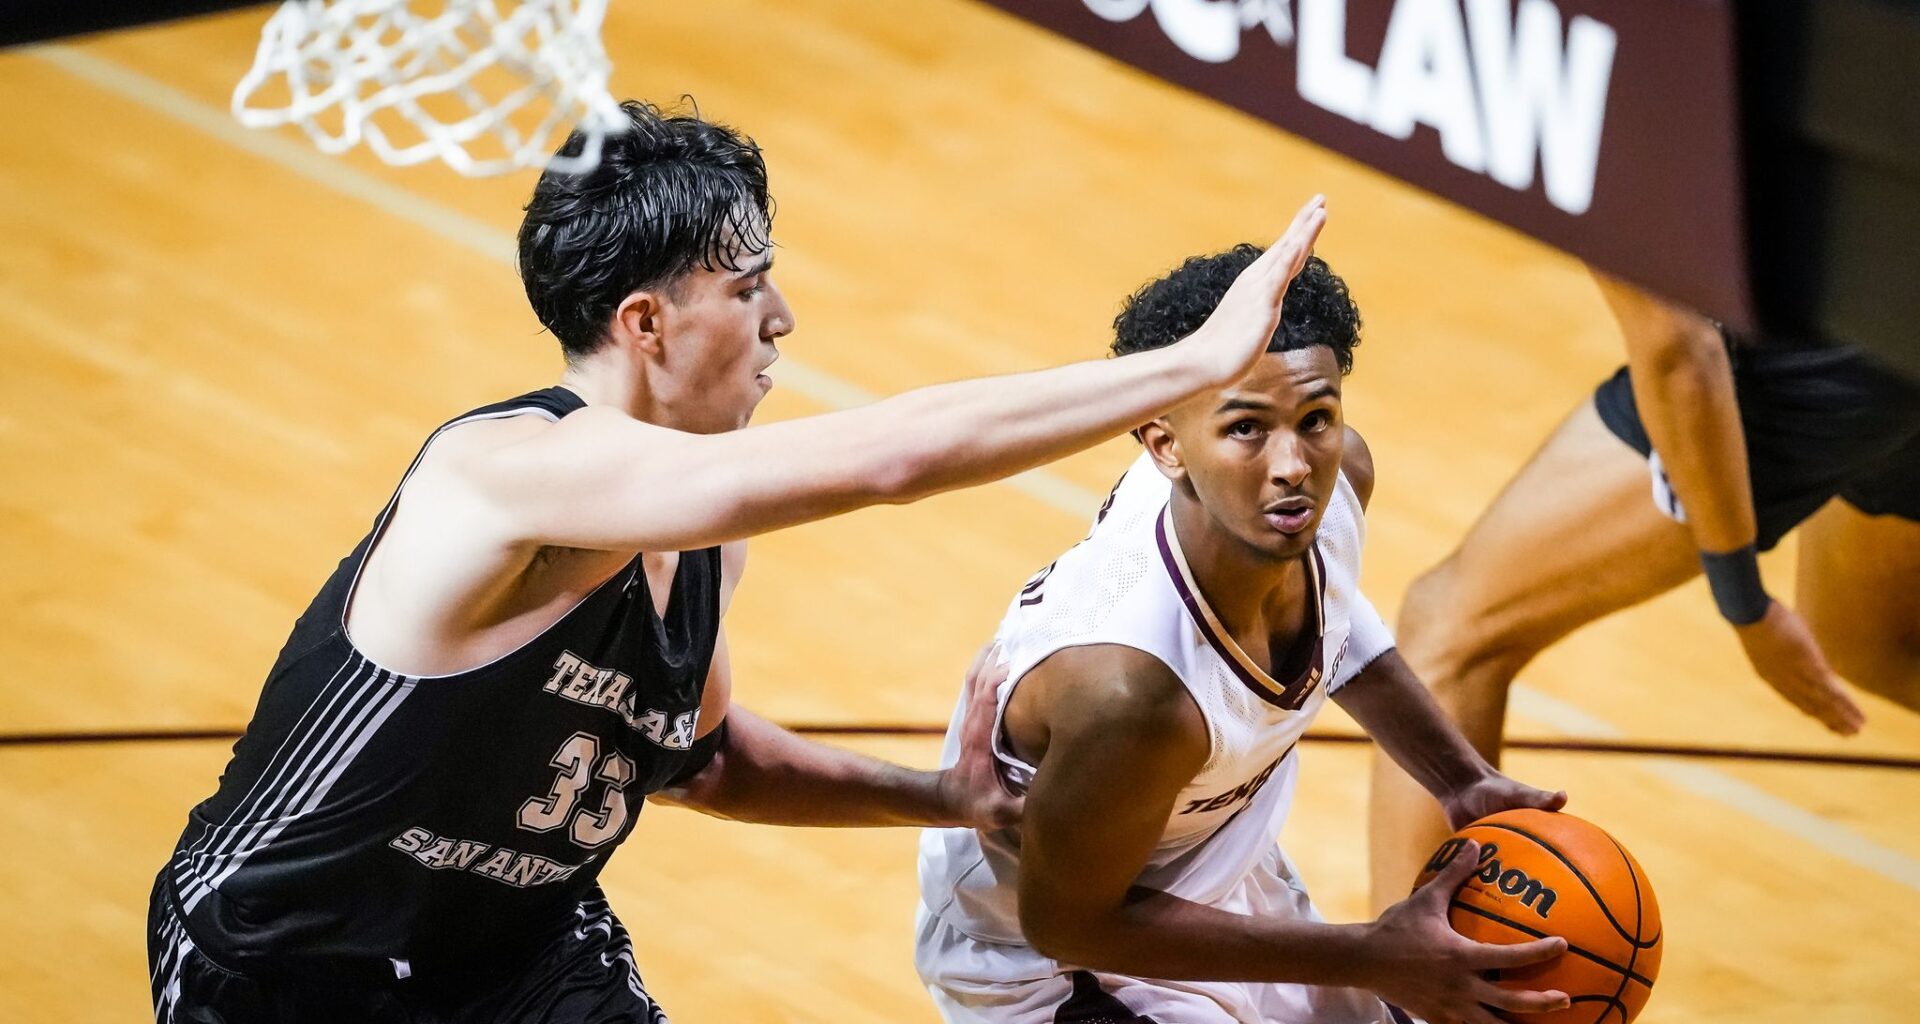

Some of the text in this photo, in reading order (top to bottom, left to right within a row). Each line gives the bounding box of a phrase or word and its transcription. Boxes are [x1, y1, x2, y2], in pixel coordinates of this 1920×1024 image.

[1296, 0, 1617, 216] LAW
[631, 704, 701, 750] A&
[516, 731, 636, 849] 33
[1178, 741, 1297, 816] TEXA
[388, 826, 492, 870] SAN
[1424, 837, 1558, 919] Wlson
